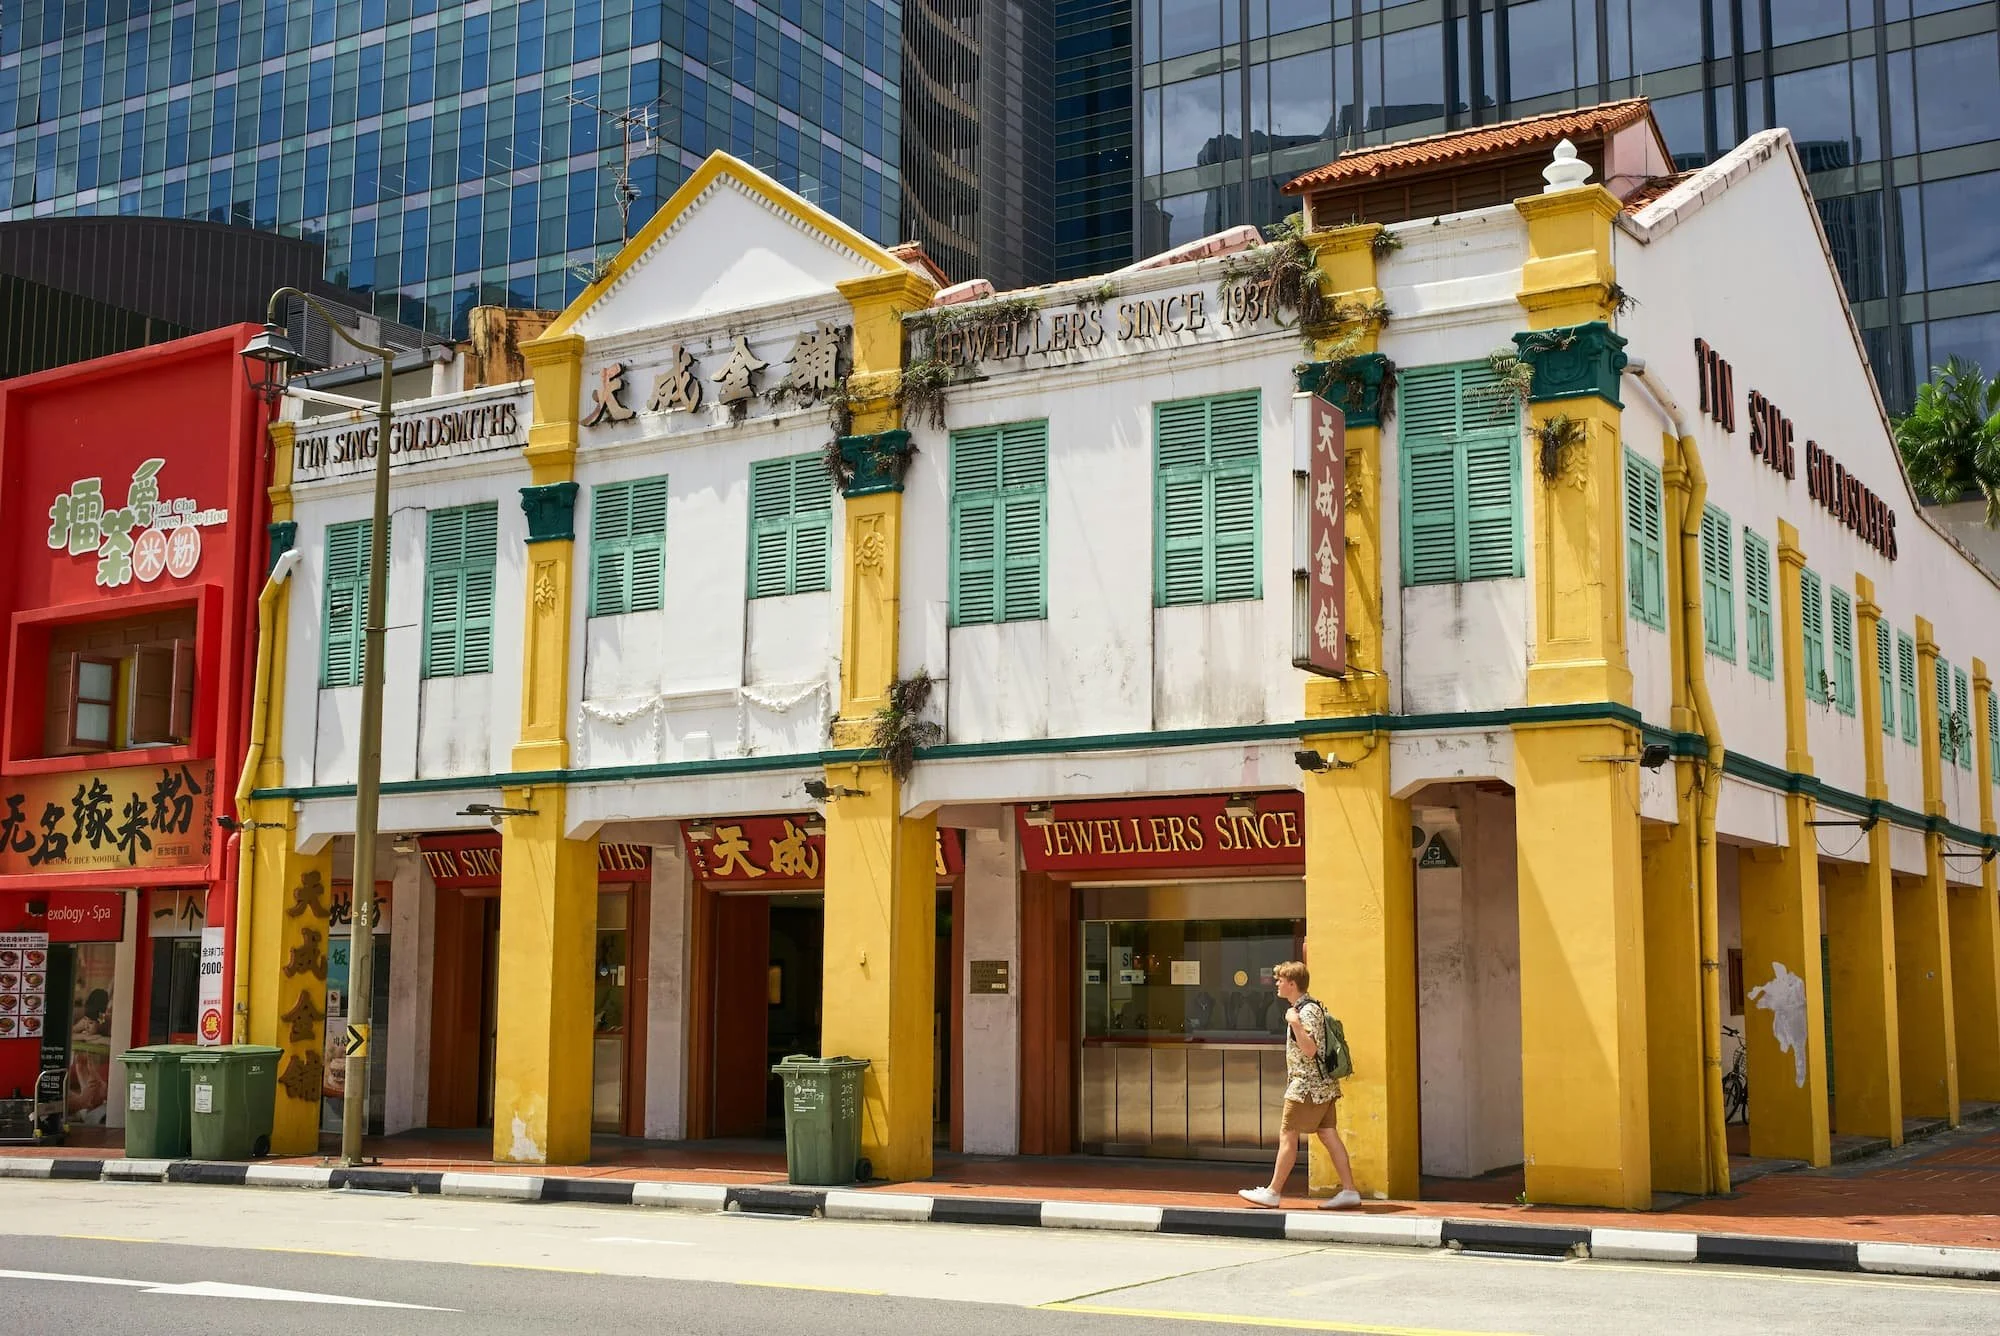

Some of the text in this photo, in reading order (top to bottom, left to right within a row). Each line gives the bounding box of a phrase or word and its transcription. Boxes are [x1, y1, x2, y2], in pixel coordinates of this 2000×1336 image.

[1119, 290, 1206, 341] SINCE
[1221, 280, 1275, 323] 1937
[296, 403, 518, 469] TIN SING GOLDSMITHS
[1694, 337, 1898, 561] TIN SING GOLDSMITHS
[154, 500, 195, 514] Lei Cha
[1042, 811, 1302, 857] JEWELLERS SINCE
[421, 850, 460, 878] TIN
[93, 905, 110, 922] Spa
